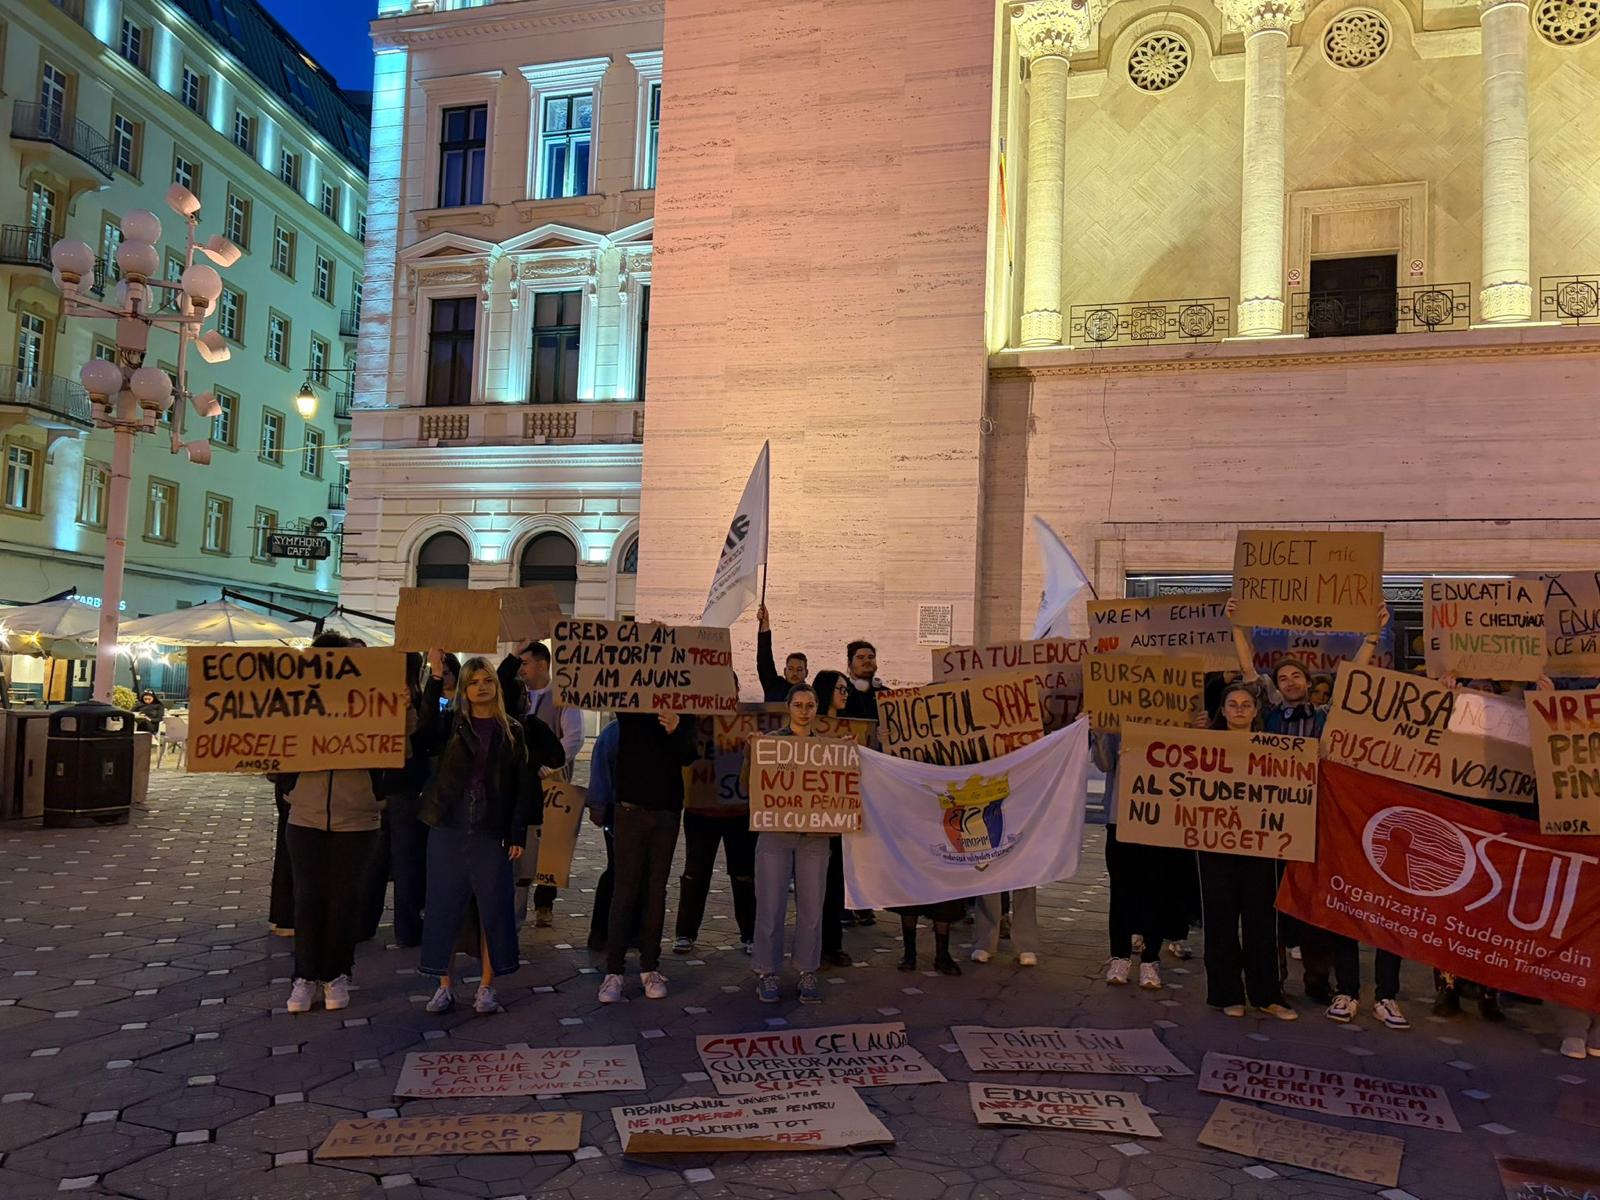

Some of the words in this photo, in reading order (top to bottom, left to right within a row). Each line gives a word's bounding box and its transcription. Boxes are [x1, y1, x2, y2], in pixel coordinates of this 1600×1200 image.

[272, 535, 326, 548] SYMPHONY
[1242, 539, 1319, 567] BUGET
[1316, 572, 1375, 606] MARI
[1095, 607, 1151, 625] VREM
[1281, 614, 1333, 629] ANOSR
[1432, 602, 1458, 630] NU
[1465, 611, 1473, 627] E
[554, 621, 609, 641] CRED
[650, 626, 676, 645] AM
[1292, 637, 1320, 648] SAU
[1431, 637, 1441, 651] E
[202, 651, 363, 682] ECONOMIA
[1090, 661, 1156, 684] BURSA
[1163, 667, 1187, 687] NU
[593, 667, 620, 688] AM
[630, 668, 692, 688] AJUNS
[347, 687, 399, 718] DIN
[1107, 688, 1132, 706] UN
[1138, 687, 1200, 713] BONUS
[1341, 668, 1454, 730] BURSA
[879, 688, 987, 746] BUGETUL
[1250, 731, 1306, 752] ANOSR
[1393, 722, 1420, 739] NU
[1424, 728, 1443, 746] E
[195, 732, 298, 759] BURSELE
[311, 732, 406, 755] NOASTRE
[234, 758, 281, 771] ANOSR
[1247, 752, 1316, 784] MINIM
[761, 769, 795, 791] NU
[802, 769, 860, 795] ESTE
[1131, 773, 1163, 796] AL
[1168, 771, 1314, 806] STUDENTULUI
[763, 793, 803, 809] DOAR
[752, 810, 779, 829] CEI
[783, 810, 806, 828] CU
[1129, 799, 1161, 825] NU
[1545, 819, 1591, 833] ANOSR
[1329, 874, 1438, 927] Organizația
[1443, 915, 1555, 959] Studenților
[1559, 947, 1593, 968] din
[1325, 894, 1419, 940] Universitatea
[1421, 930, 1444, 948] de
[1447, 937, 1480, 961] Vest
[1484, 952, 1510, 970] din
[702, 1035, 814, 1060] STATUL
[815, 1033, 846, 1055] SE
[413, 1062, 529, 1078] TREBUIE
[710, 1059, 745, 1074] CU
[866, 1064, 900, 1075] NU
[1211, 1069, 1238, 1081] LA
[431, 1070, 561, 1087] CRITERIU
[577, 1069, 611, 1079] DE
[622, 1099, 731, 1117] ABANDONUL
[627, 1118, 650, 1130] NE
[765, 1119, 816, 1130] TOT
[373, 1132, 418, 1145] UN
[424, 1128, 521, 1142] POPOR
